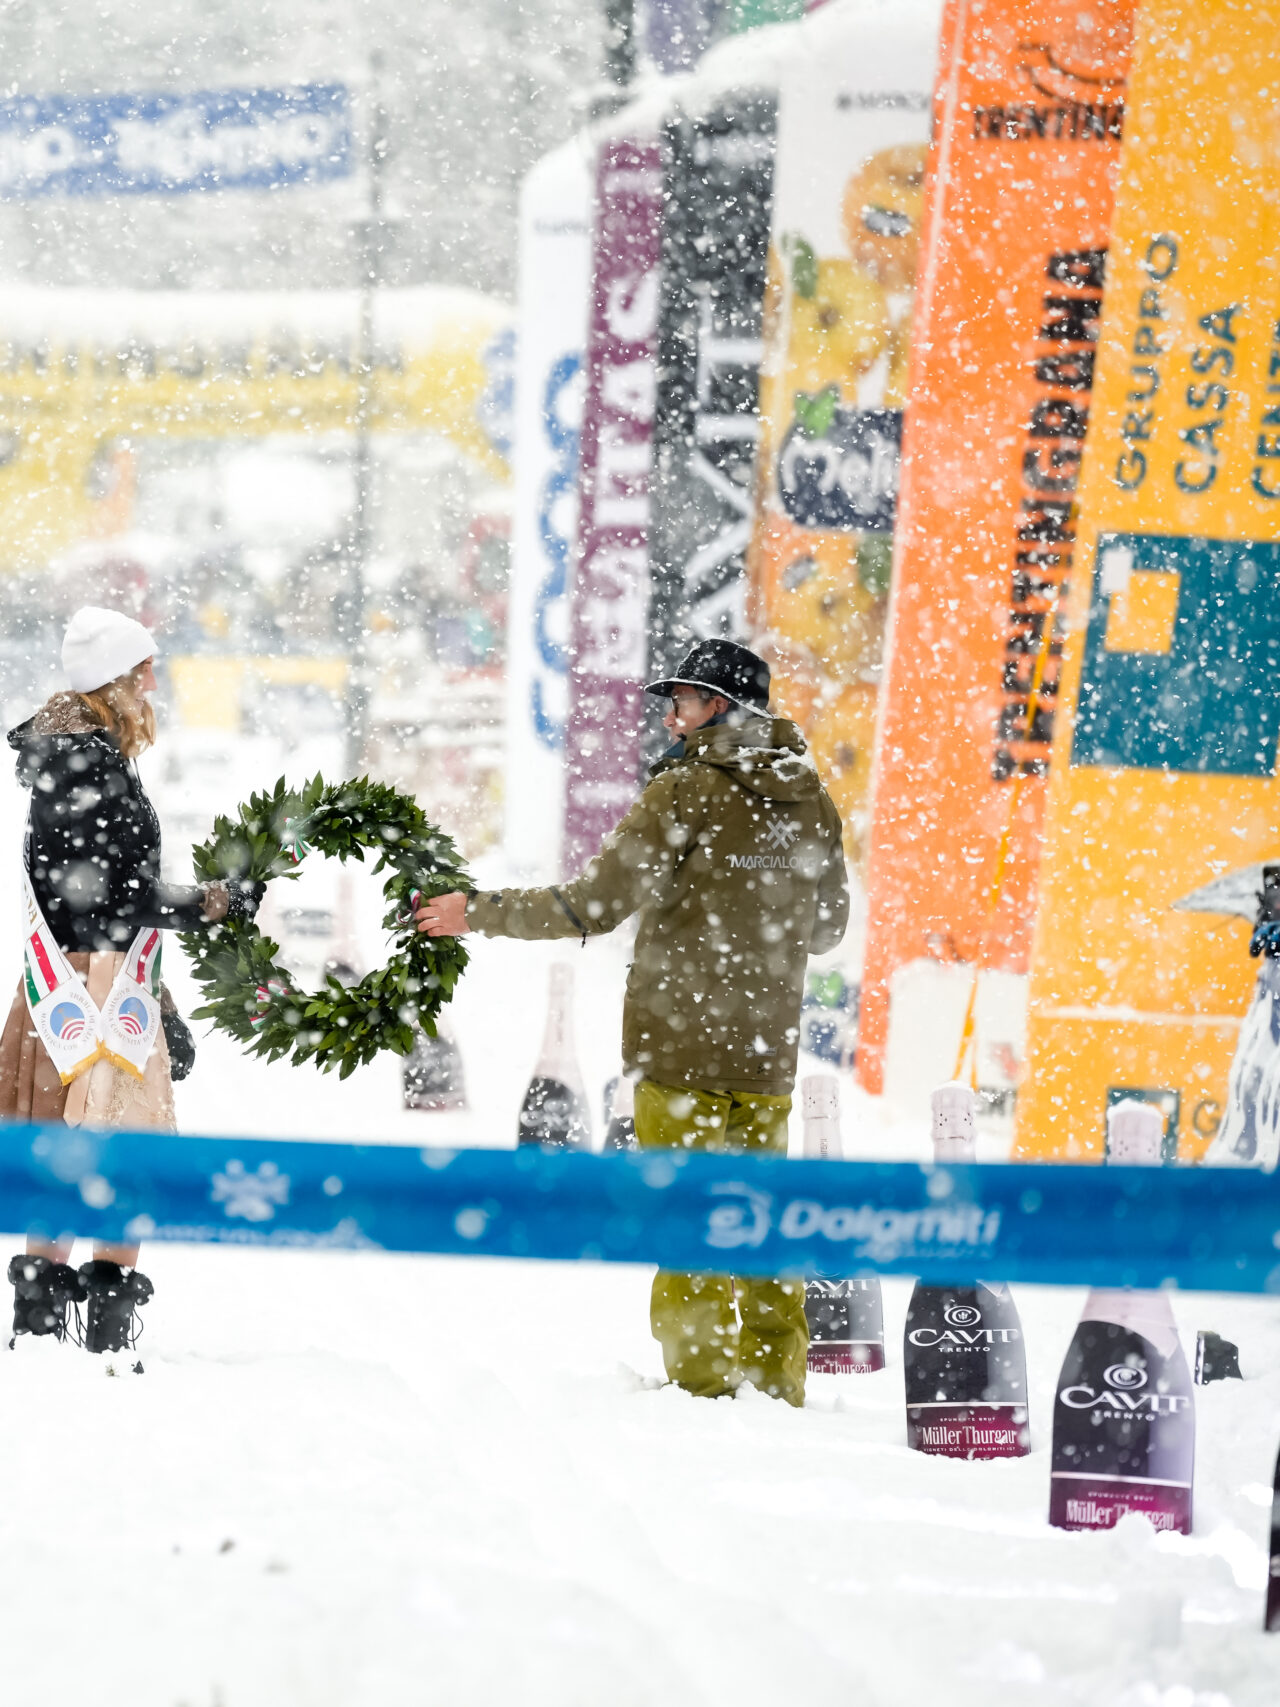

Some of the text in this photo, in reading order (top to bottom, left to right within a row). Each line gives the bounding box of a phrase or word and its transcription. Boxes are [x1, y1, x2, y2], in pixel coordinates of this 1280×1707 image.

[1116, 233, 1179, 492] GRUPPO
[592, 267, 661, 528] ITAS
[1175, 303, 1241, 494] CASSA
[683, 290, 764, 640] AVIT
[991, 247, 1110, 783] TRENTINGRANA
[780, 1200, 1001, 1247] Dolomiti
[805, 1279, 874, 1291] AVIT
[908, 1328, 1018, 1346] CAVIT
[807, 1361, 826, 1373] ller
[1060, 1386, 1190, 1413] CAVIT
[1094, 1410, 1156, 1422] TRENTO
[922, 1425, 1016, 1445] Müller Thurgau
[1066, 1499, 1113, 1525] Müller
